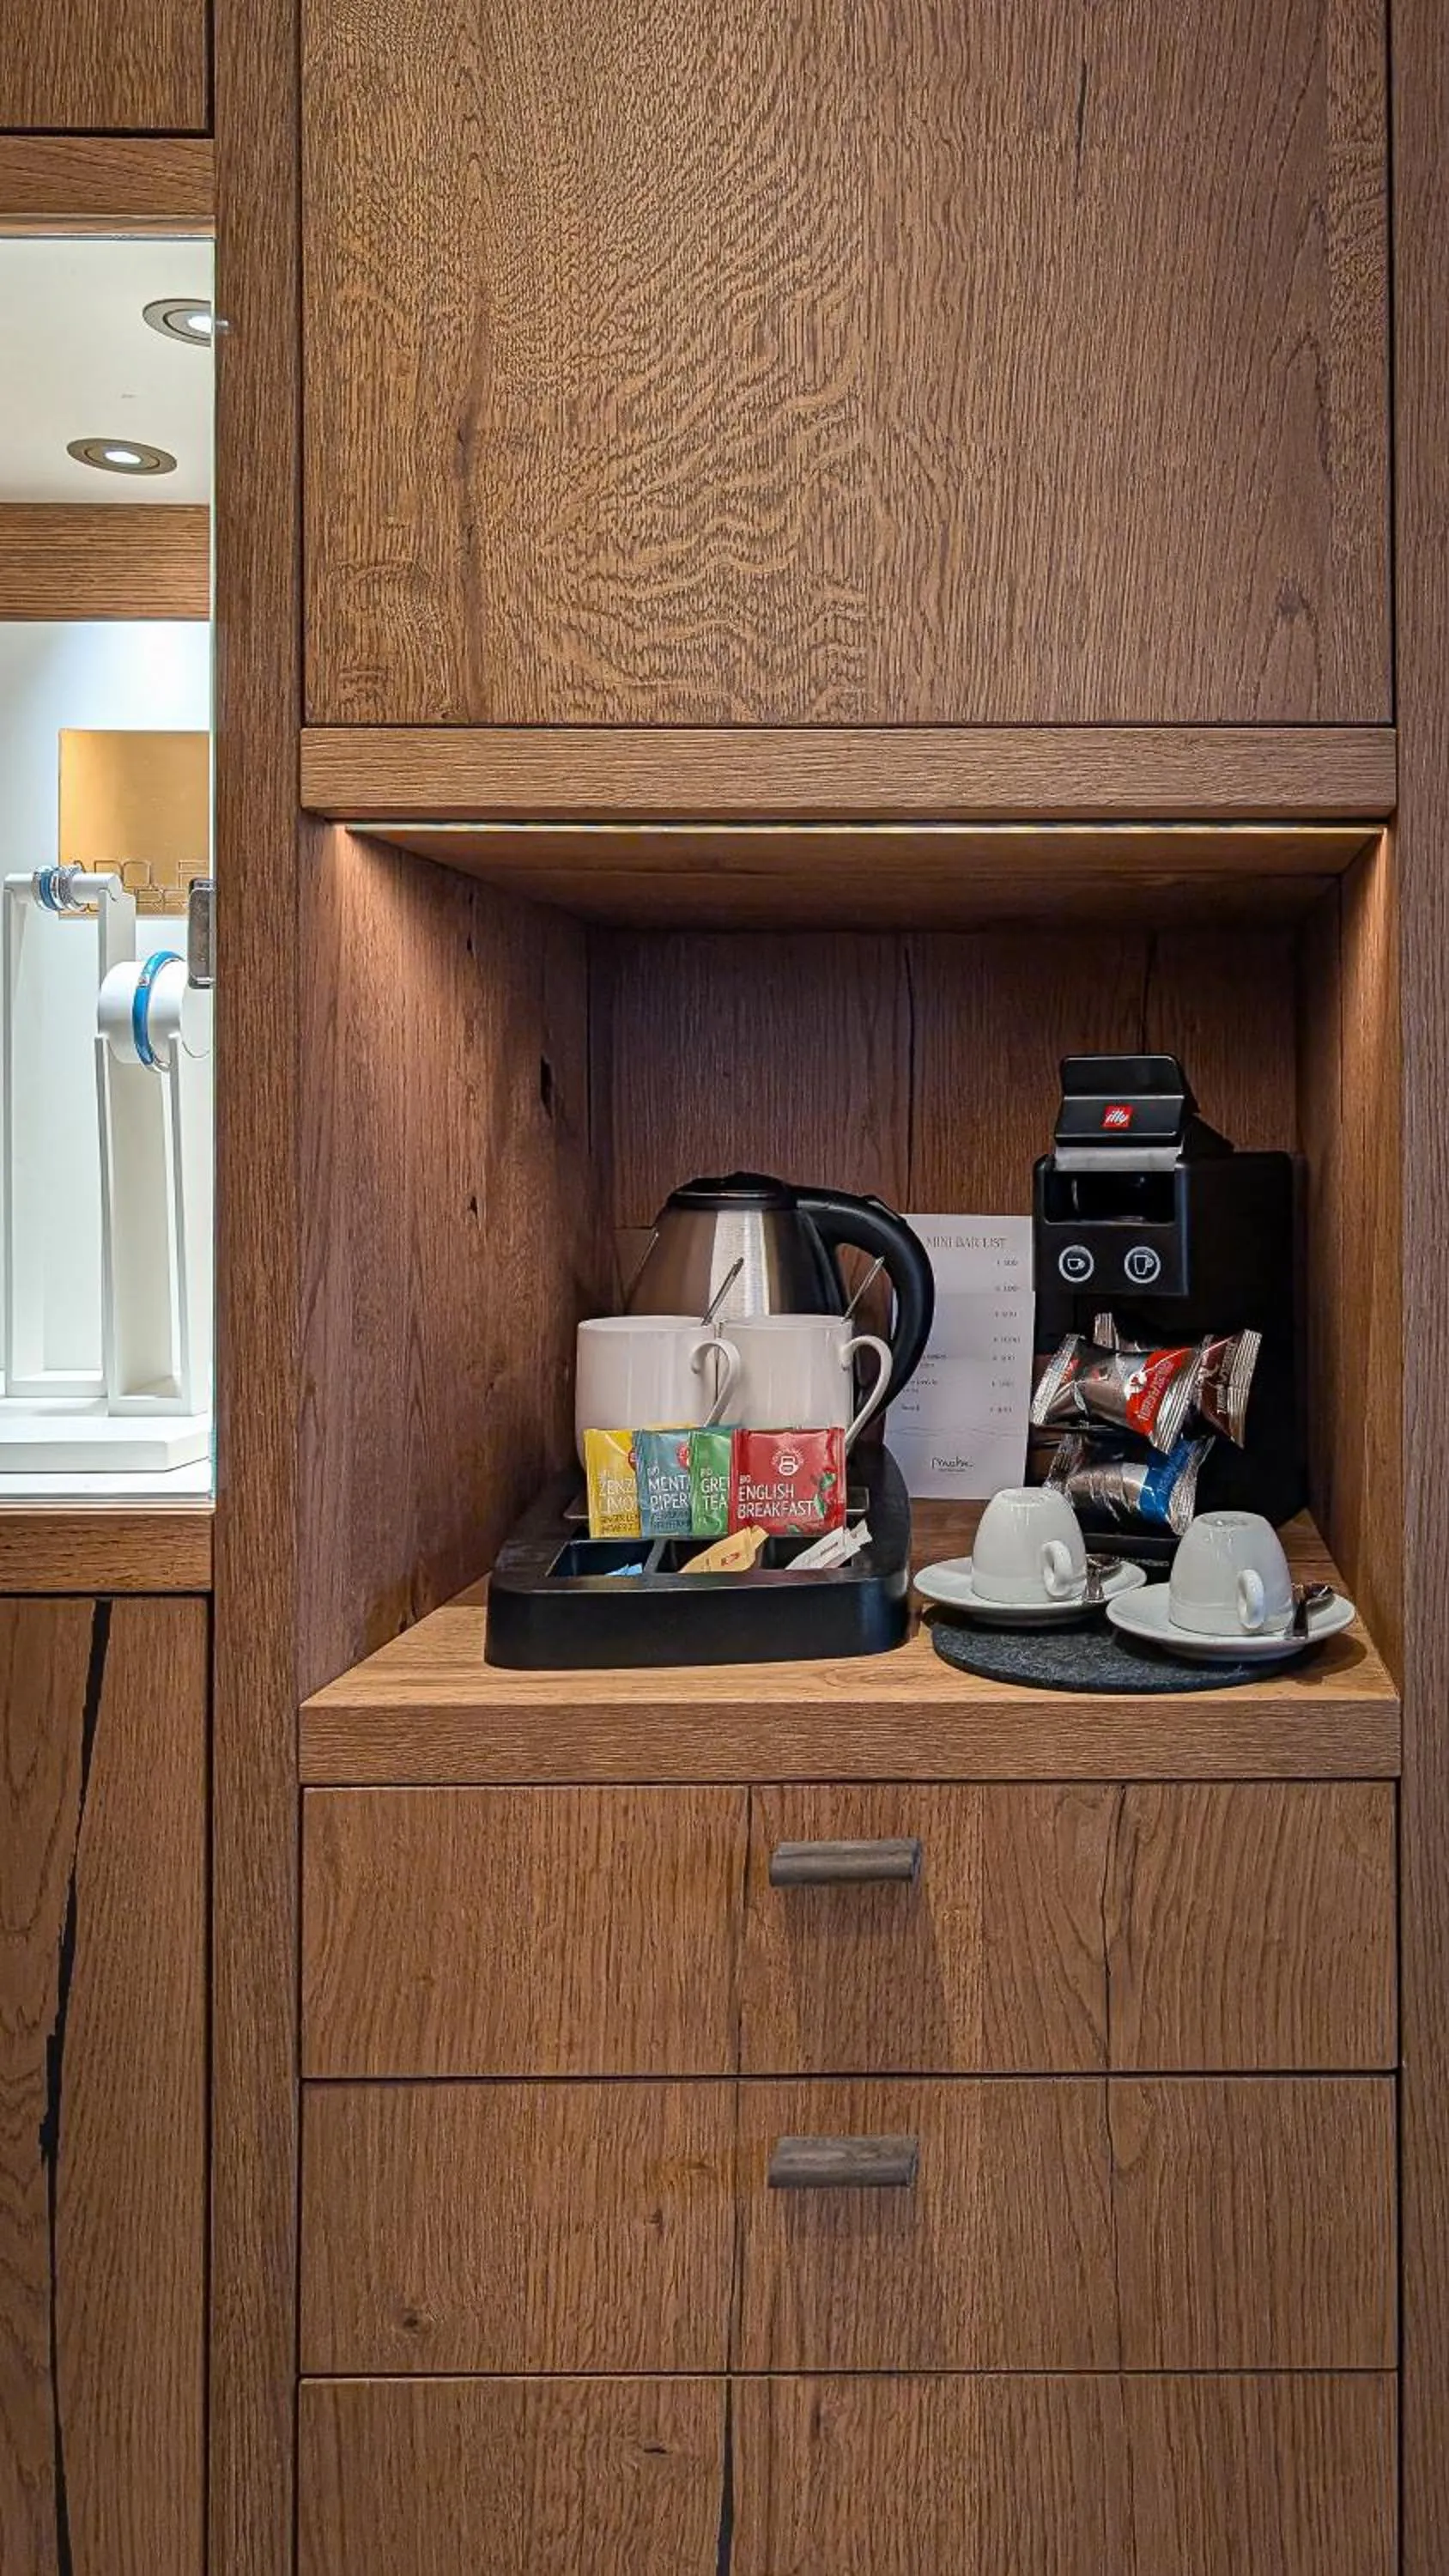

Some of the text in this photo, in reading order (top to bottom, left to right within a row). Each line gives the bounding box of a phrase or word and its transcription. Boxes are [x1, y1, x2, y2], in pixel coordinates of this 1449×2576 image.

[1106, 1110, 1130, 1124] illy
[700, 1476, 730, 1493] GRE
[738, 1483, 794, 1502] ENGLISH
[702, 1494, 729, 1511] TEA
[737, 1500, 814, 1519] BREAKFAST
